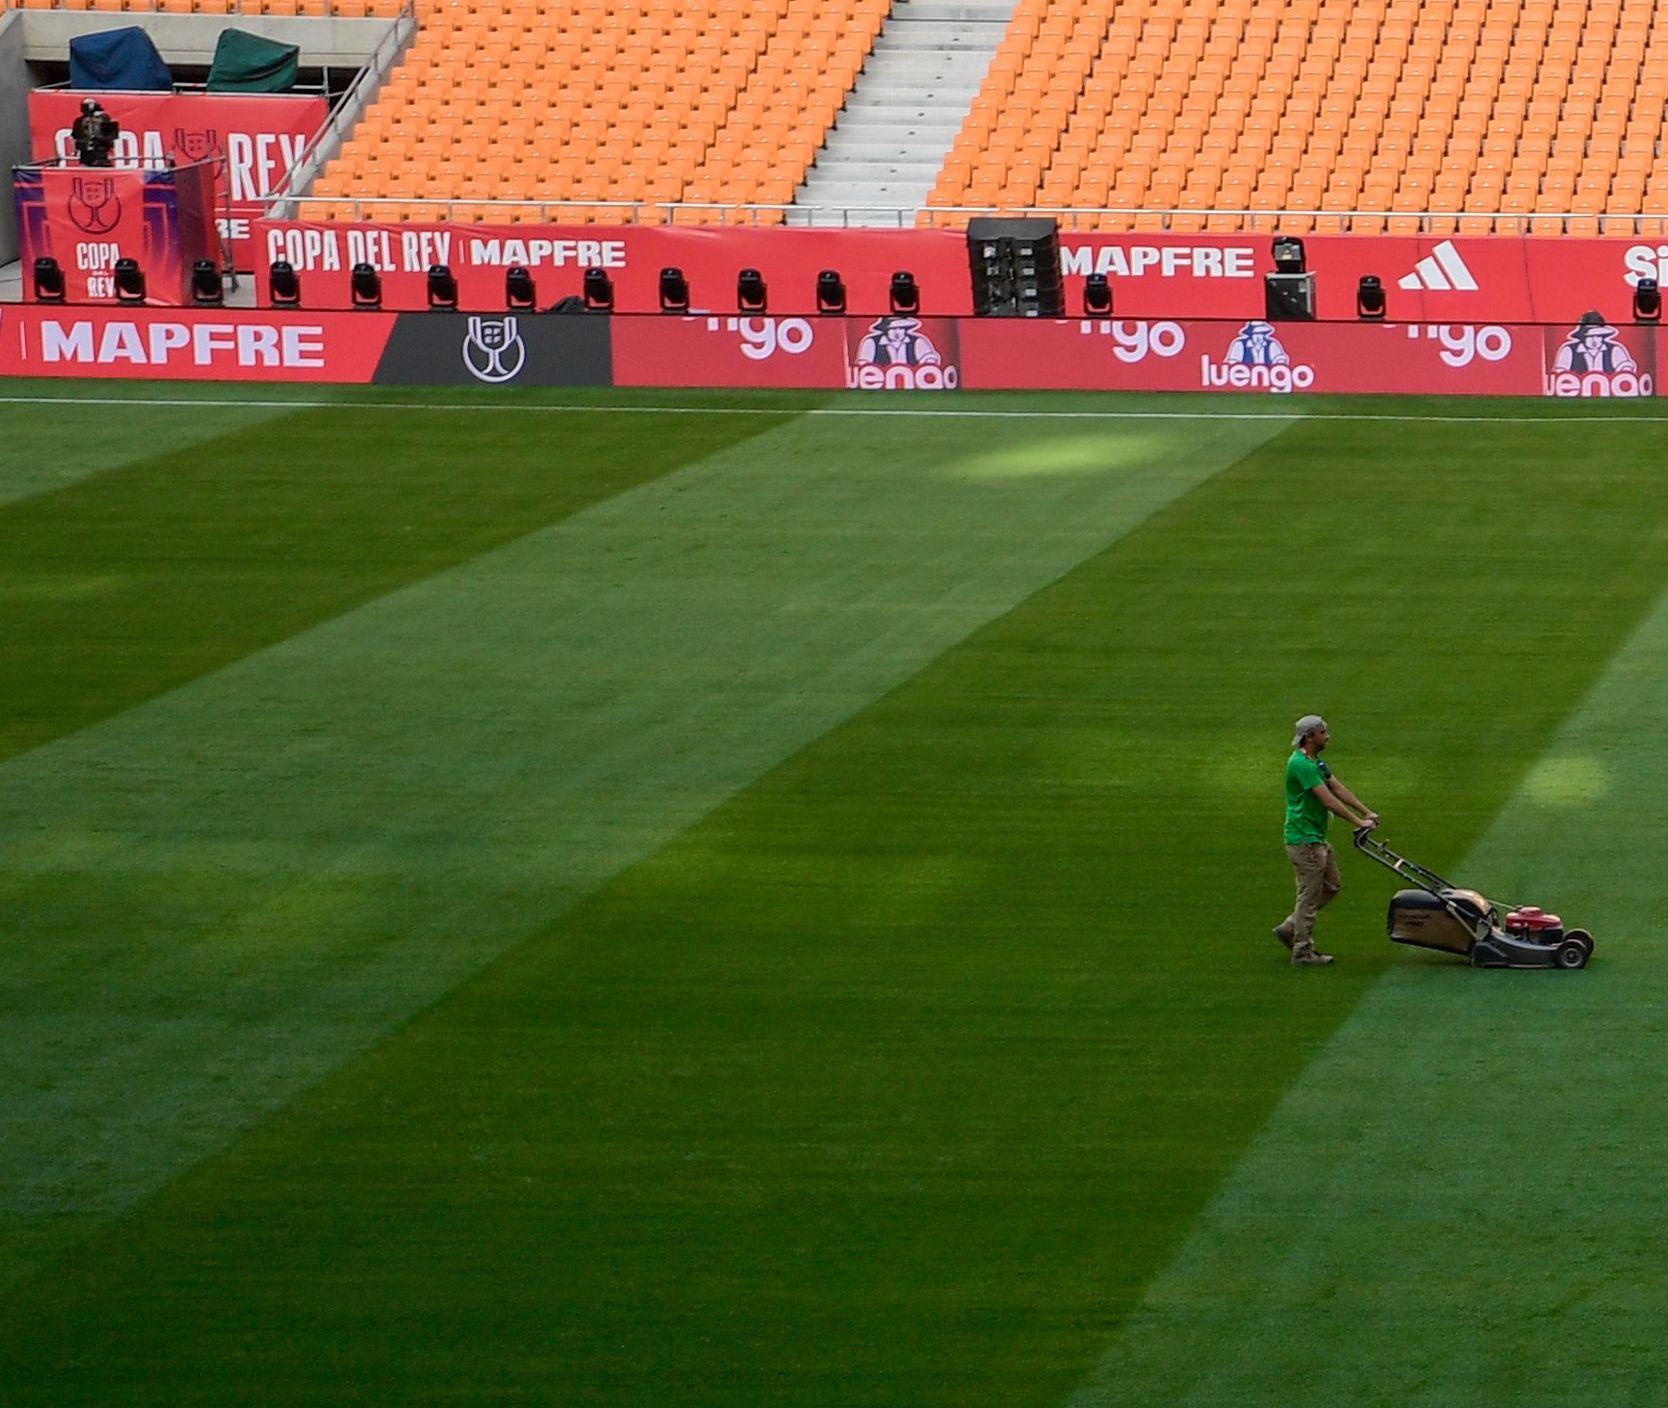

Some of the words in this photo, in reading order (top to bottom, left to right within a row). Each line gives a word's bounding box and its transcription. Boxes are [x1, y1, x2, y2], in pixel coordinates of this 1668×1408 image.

[75, 242, 120, 271] COPA
[267, 228, 341, 272] COPA
[346, 230, 396, 272] DEL
[401, 231, 451, 272] REY
[470, 239, 626, 268] MAPFRE
[1059, 246, 1255, 277] MAPFRE
[41, 320, 325, 368] MAPFRE
[1201, 354, 1315, 394] luengo
